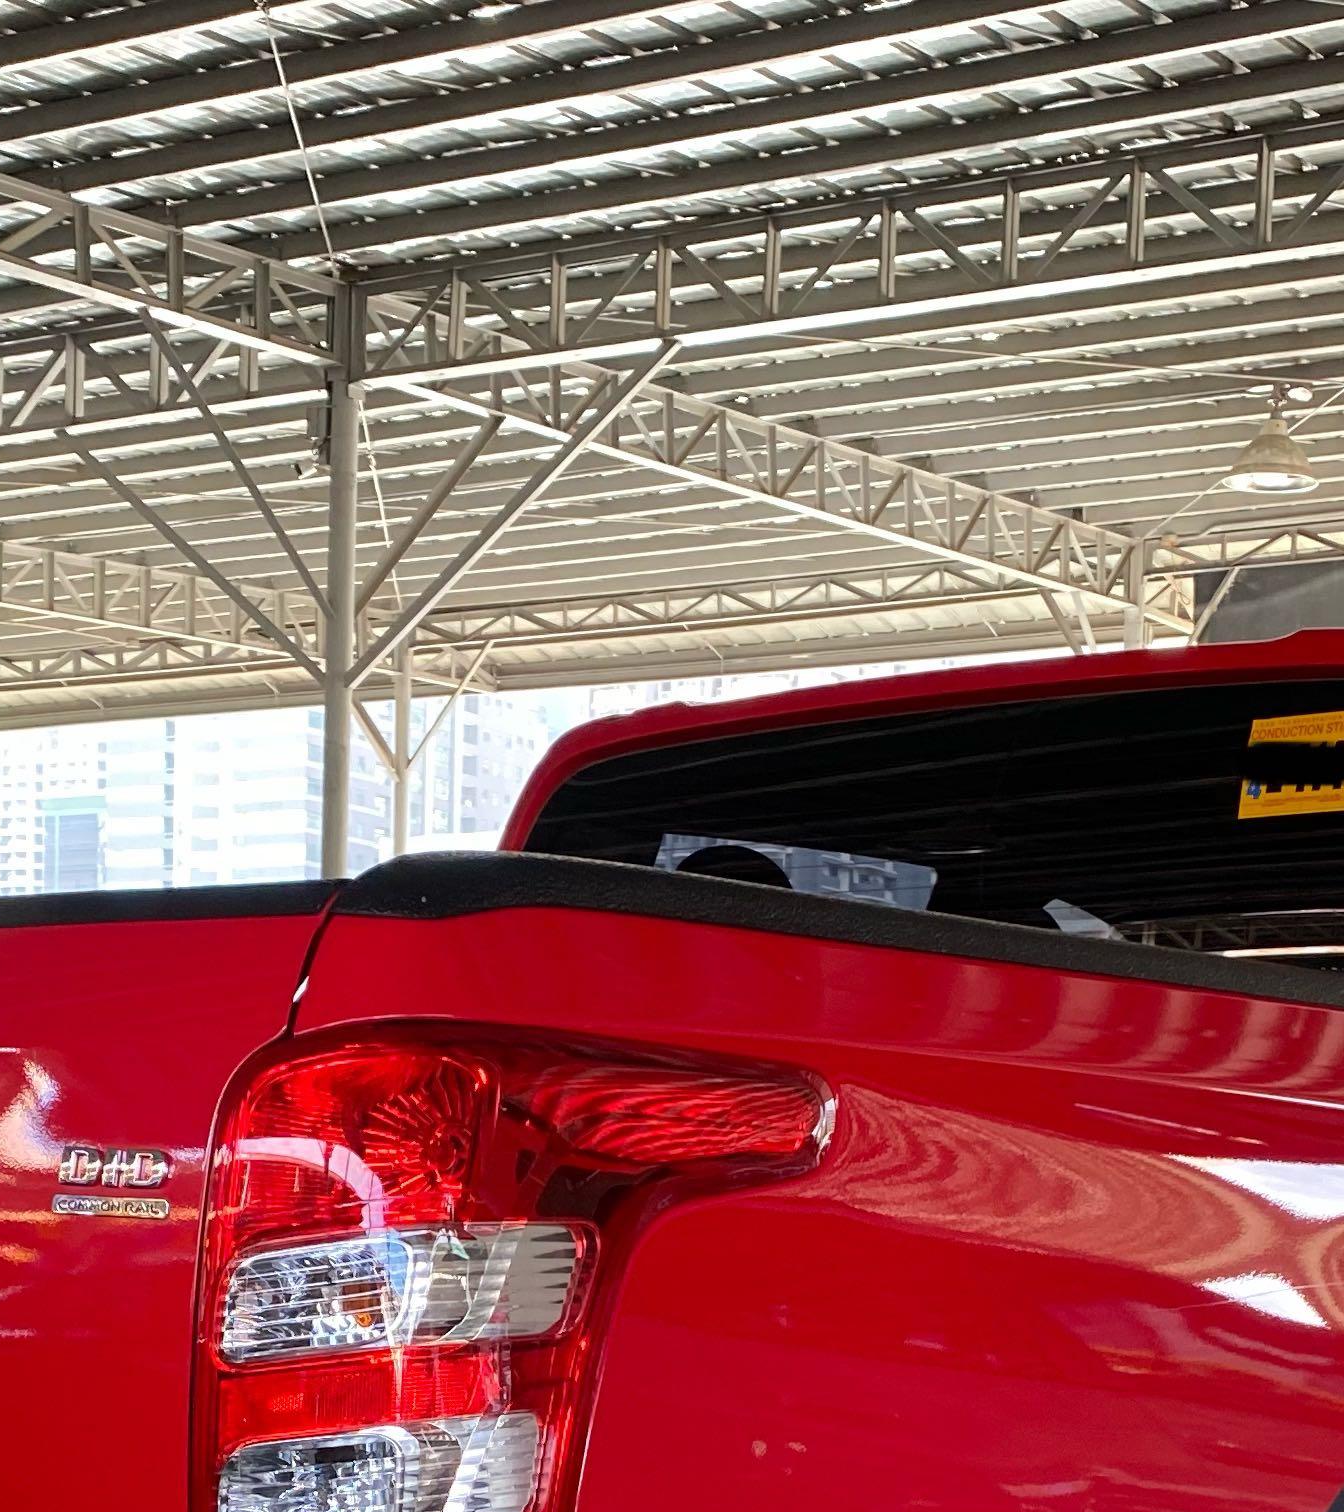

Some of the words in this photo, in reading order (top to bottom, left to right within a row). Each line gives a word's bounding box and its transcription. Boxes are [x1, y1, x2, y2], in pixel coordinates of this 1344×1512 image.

[1251, 723, 1324, 741] CONDUCTION
[57, 1198, 121, 1214] COMMON
[124, 1200, 160, 1215] RAIL
